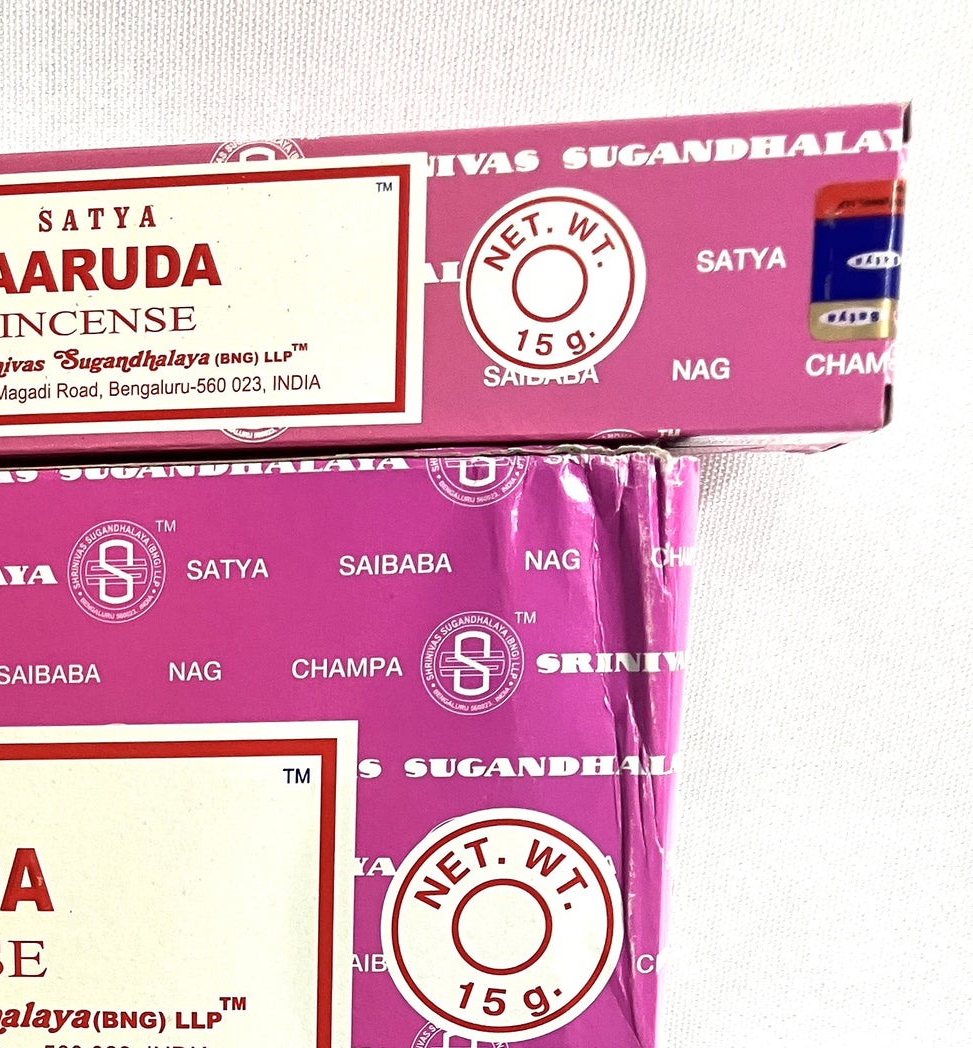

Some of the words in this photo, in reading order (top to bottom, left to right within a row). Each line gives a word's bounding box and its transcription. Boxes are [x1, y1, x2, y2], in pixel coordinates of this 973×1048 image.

[375, 181, 393, 193] TM
[38, 205, 157, 233] SATYA
[483, 212, 554, 271] NET.
[569, 212, 616, 269] WT.
[696, 246, 787, 273] SATYA
[0, 305, 197, 339] INCENSE
[517, 329, 554, 357] 15
[566, 328, 597, 355] g.
[54, 347, 210, 371] Sugandhalaya
[214, 351, 259, 368] (BNG)
[672, 357, 731, 381] NAG
[56, 381, 103, 400] Road,
[109, 377, 227, 400] Bengaluru-560
[231, 374, 267, 397] 023,
[273, 374, 321, 391] INDIA
[155, 519, 176, 532] TM
[186, 558, 269, 581] SATYA
[339, 552, 453, 576] SAIBABA
[525, 548, 581, 571] NAG
[514, 611, 537, 624] TM
[169, 660, 222, 682] NAG
[291, 656, 403, 679] CHAMPA
[282, 767, 311, 784] TM
[414, 837, 507, 910] NET.
[526, 839, 589, 910] WT.
[459, 982, 507, 1016] 15
[524, 985, 562, 1018] g.
[92, 1012, 168, 1033] (BNG)
